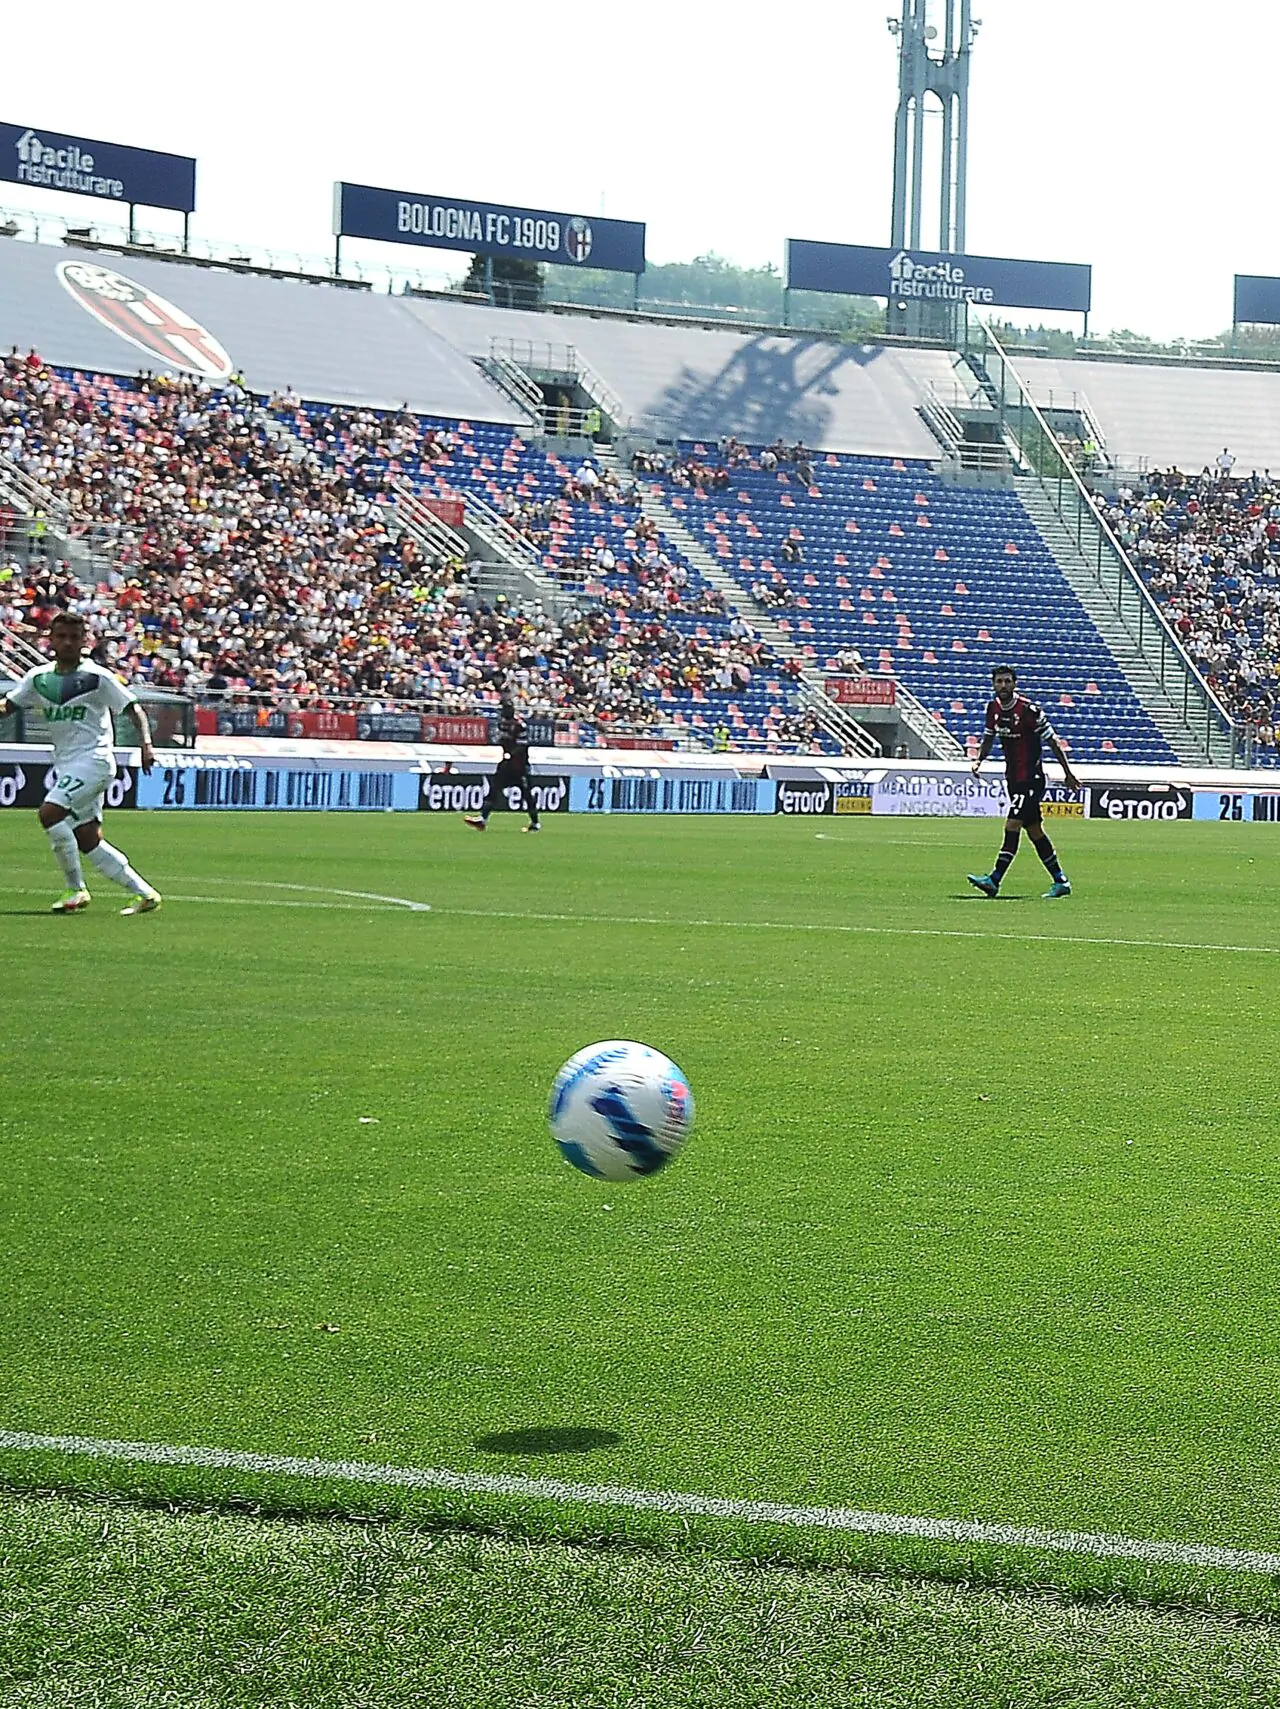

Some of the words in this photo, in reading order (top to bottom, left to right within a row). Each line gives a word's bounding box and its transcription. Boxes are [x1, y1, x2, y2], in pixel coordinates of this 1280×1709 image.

[18, 162, 124, 197] ristrutturare
[398, 201, 483, 241] BOLOGNA
[486, 213, 510, 245] FC
[513, 217, 560, 251] 1909
[891, 279, 994, 302] ristrutturare
[58, 775, 84, 792] 97
[164, 769, 184, 805] 25
[588, 779, 604, 809] 25
[1008, 792, 1026, 808] 21
[1219, 793, 1242, 820] 25
